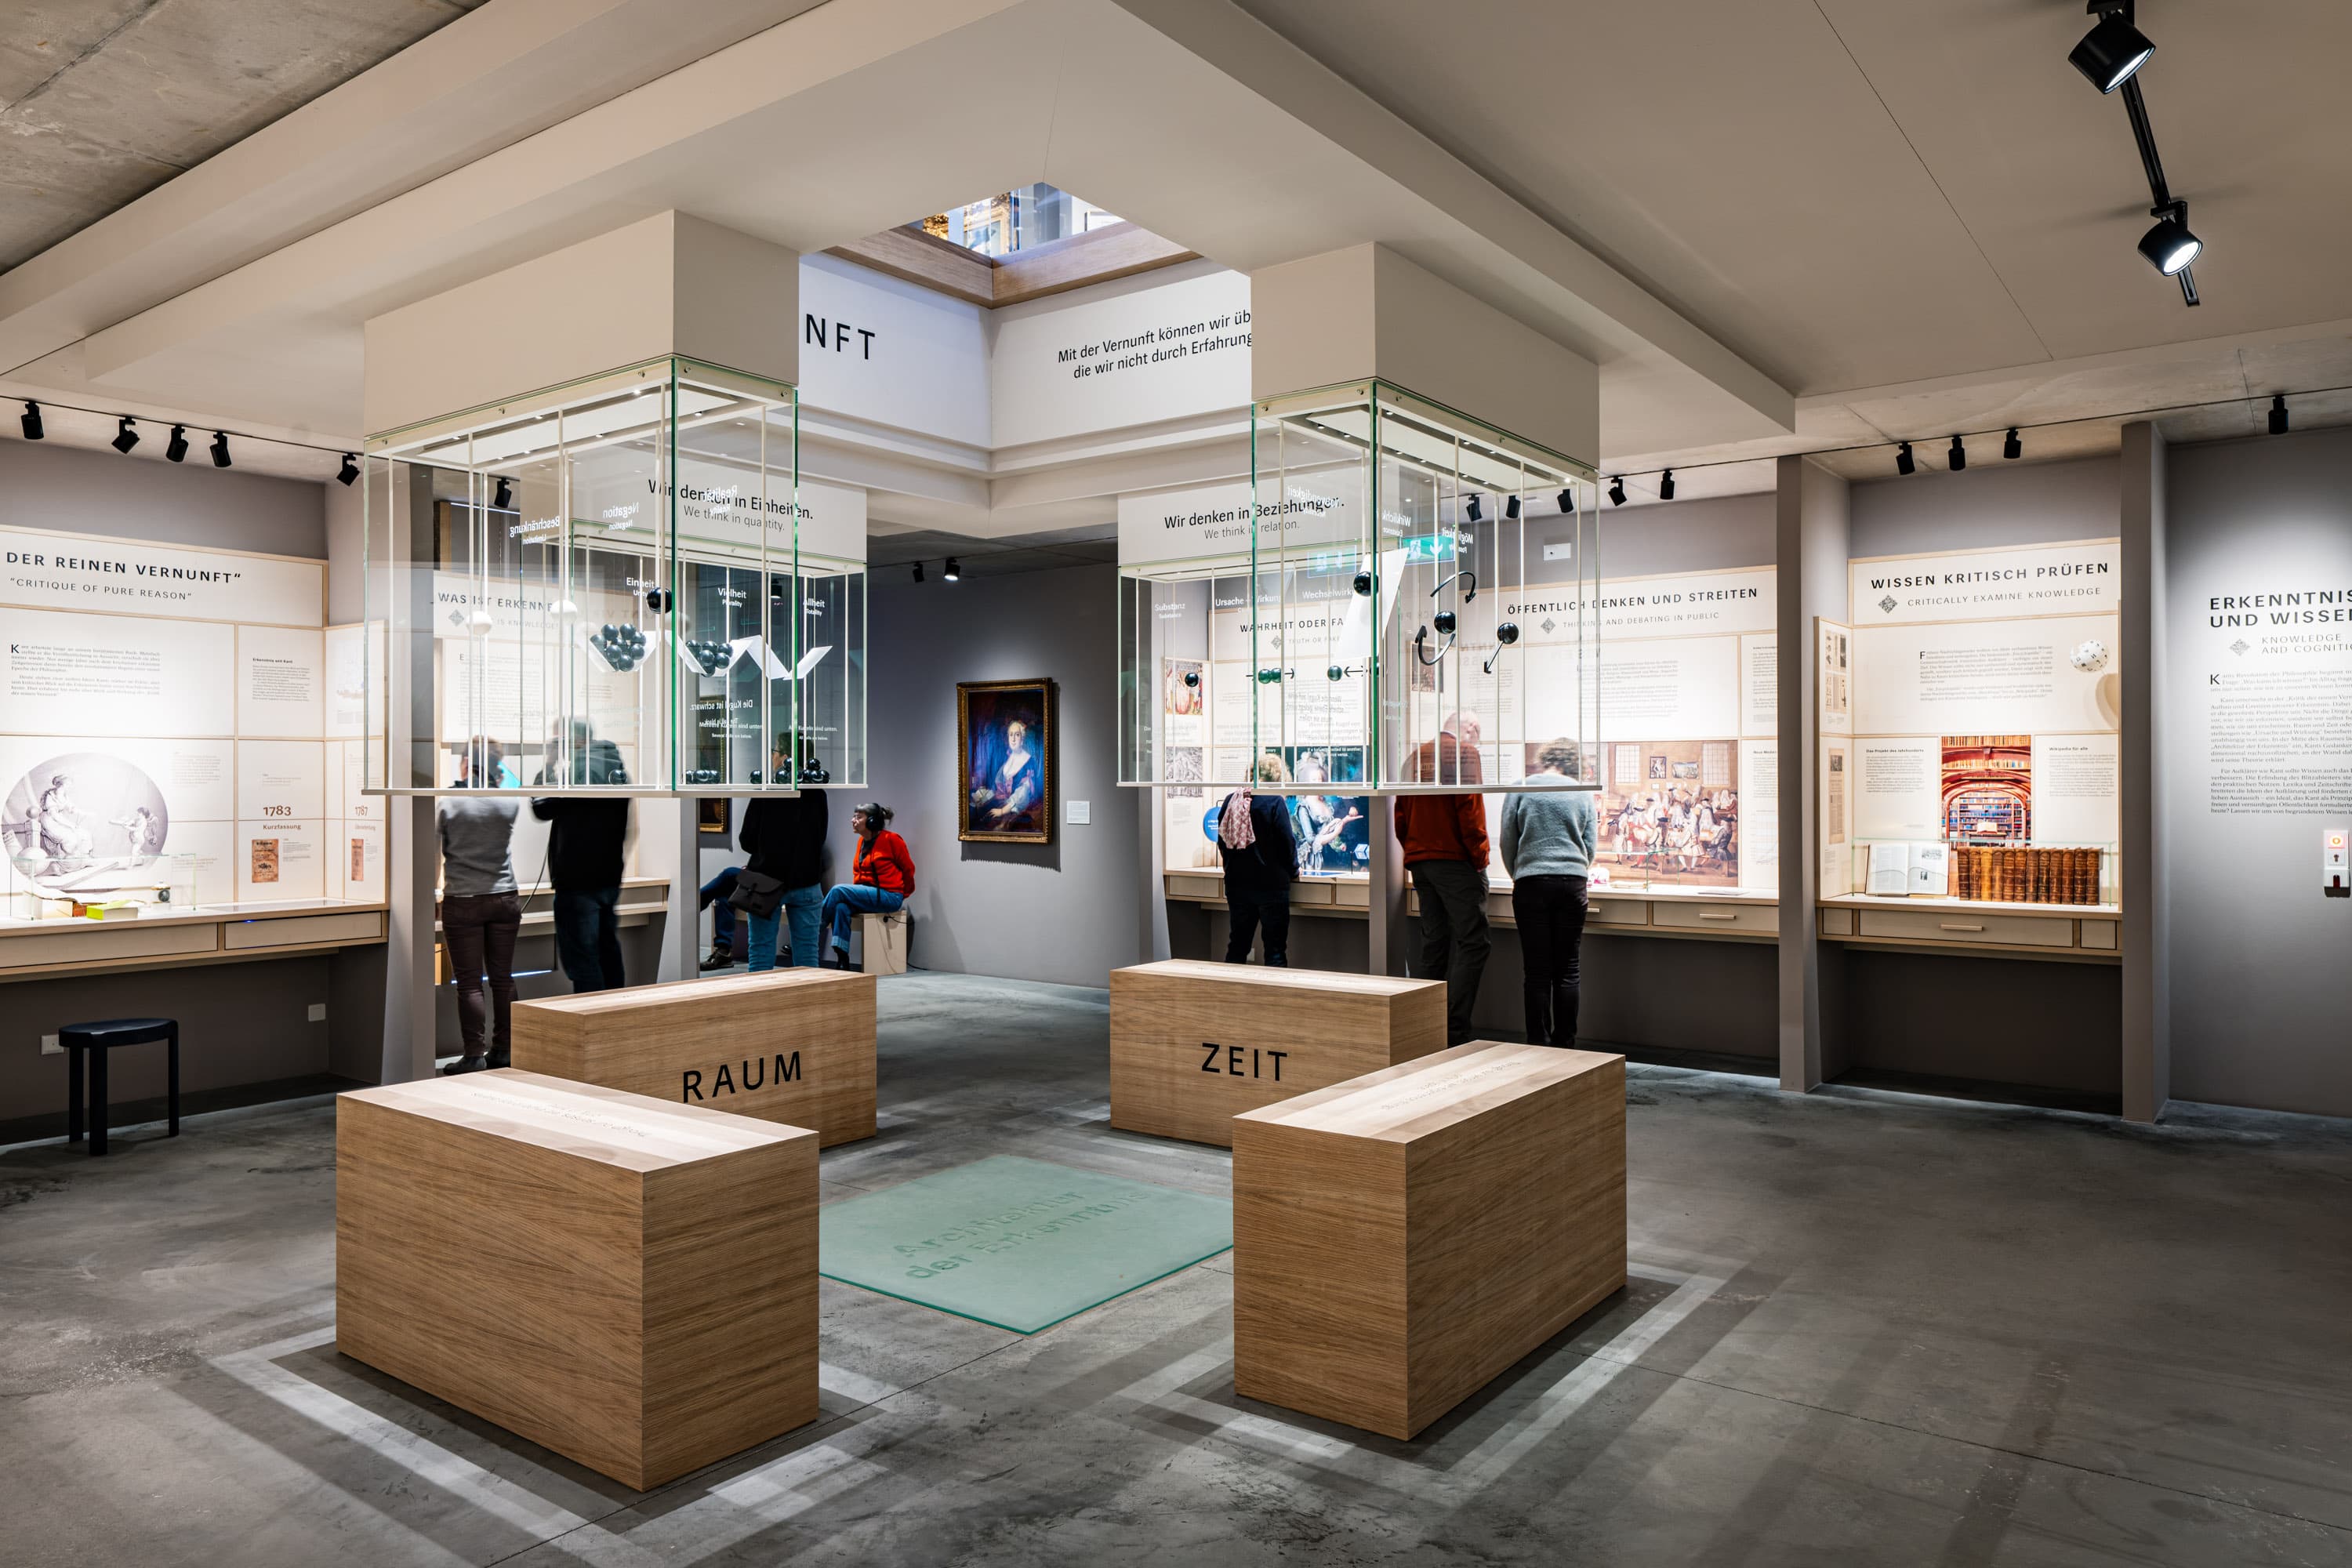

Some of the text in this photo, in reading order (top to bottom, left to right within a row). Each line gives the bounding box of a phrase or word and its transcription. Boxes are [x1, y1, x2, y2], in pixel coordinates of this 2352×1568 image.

[806, 313, 877, 361] NFT
[1058, 346, 1077, 365] Mit
[1080, 342, 1099, 360] der
[1102, 329, 1155, 354] Vernunft
[1159, 320, 1205, 341] können
[1208, 315, 1232, 332] wir
[1073, 361, 1091, 379] die
[1094, 358, 1115, 374] wir
[1117, 350, 1148, 371] nicht
[1151, 343, 1188, 365] durch
[735, 495, 746, 508] in
[684, 505, 700, 517] We
[732, 513, 741, 524] in
[1164, 515, 1185, 529] Wir
[1189, 510, 1234, 526] denken
[1239, 506, 1249, 520] in
[1204, 520, 1300, 539] We think relaton.
[7, 552, 45, 566] DER
[56, 557, 125, 573] REINEN
[1871, 563, 2108, 590] WISSEN KRITISCH PRÜFEN
[82, 584, 98, 593] OF
[104, 586, 134, 597] PURE
[438, 592, 466, 604] WAS
[1652, 593, 1682, 604] UND
[1688, 588, 1758, 602] STREITEN
[1907, 587, 2101, 607] CRITICALLY EXAMINE KNOWLEDGE
[1154, 602, 1185, 612] Substanz
[1215, 597, 1244, 607] Ursache
[1299, 619, 1327, 629] ODER
[1627, 615, 1670, 625] DEBATING
[2210, 614, 2258, 628] UND
[2262, 633, 2342, 644] KNOWLEDGE
[2261, 645, 2288, 655] AND
[263, 805, 292, 817] 1783
[355, 805, 368, 816] 1787
[1200, 1042, 1288, 1083] ZEIT
[683, 1051, 802, 1103] RAUM
[895, 1192, 1084, 1258] Architektur
[906, 1254, 973, 1279] der
